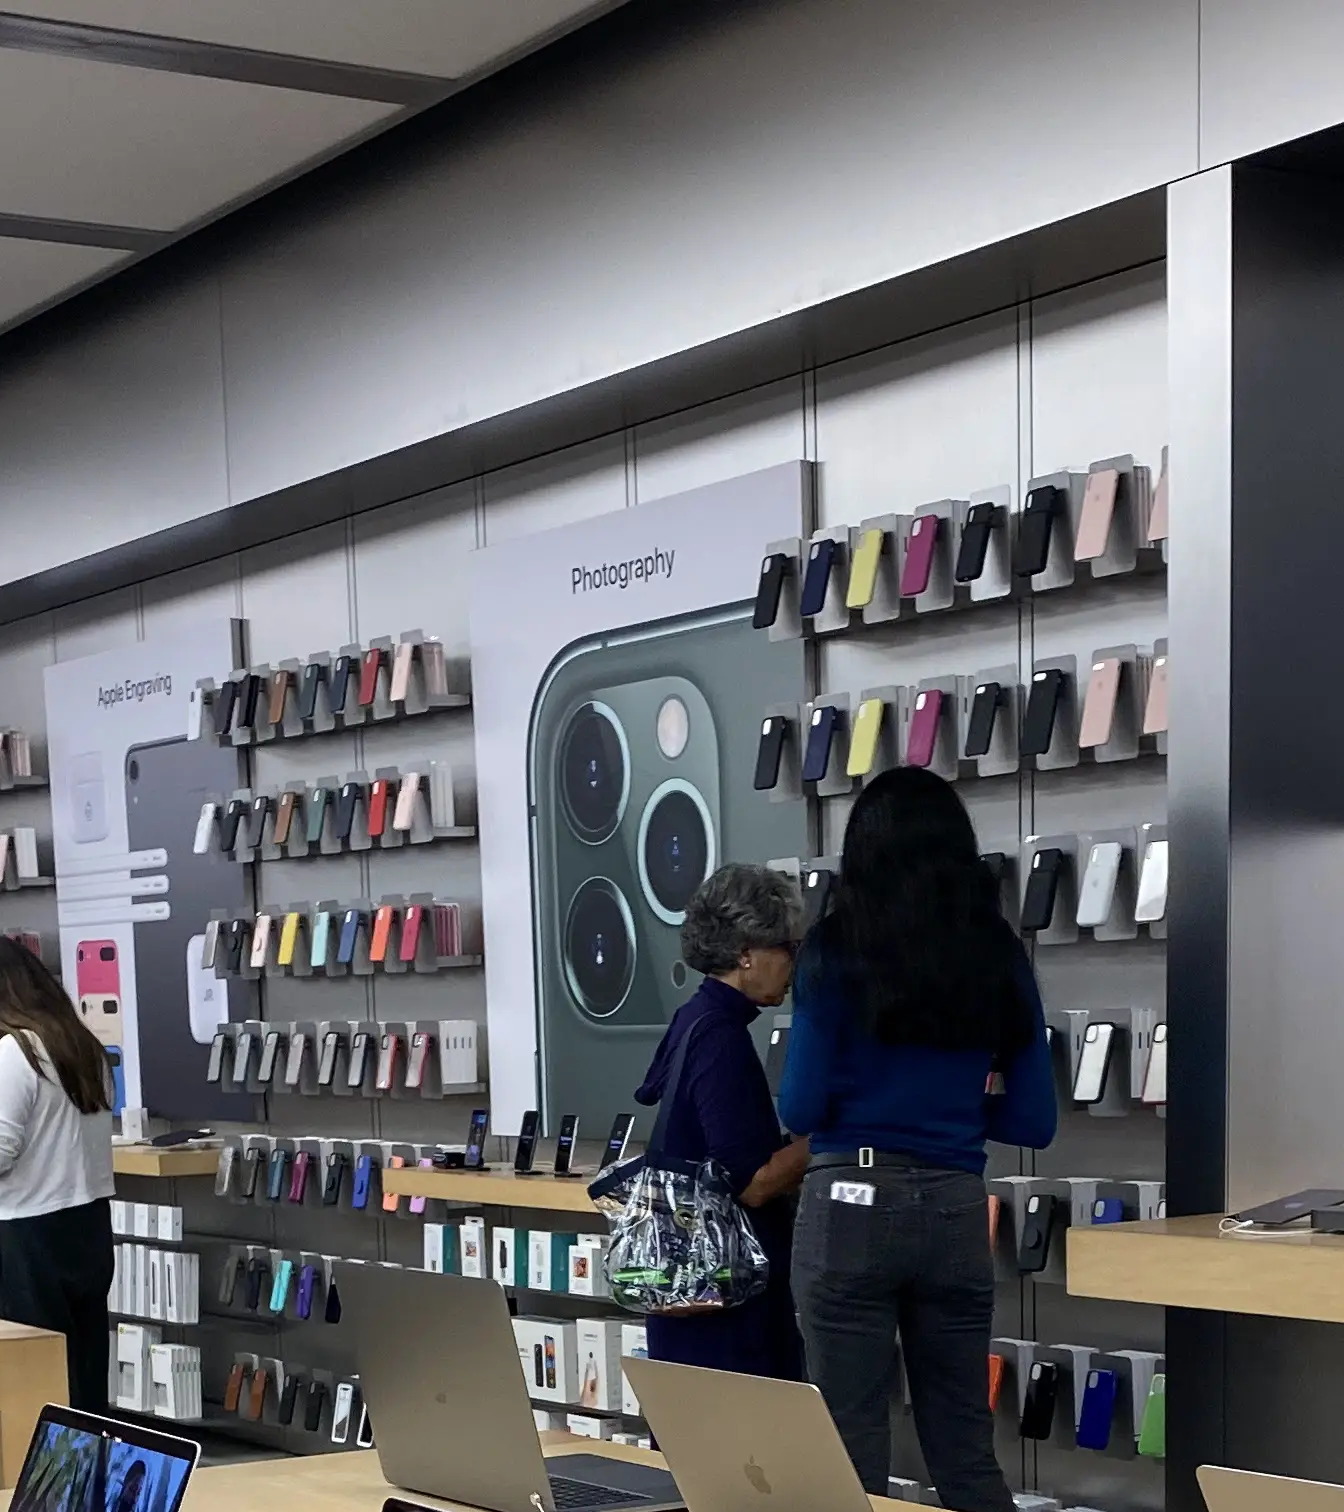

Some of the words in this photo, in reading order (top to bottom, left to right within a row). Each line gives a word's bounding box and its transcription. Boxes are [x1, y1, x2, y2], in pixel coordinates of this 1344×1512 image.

[572, 546, 676, 595] Photography
[97, 682, 124, 710] Apple
[125, 672, 172, 703] Engraving
